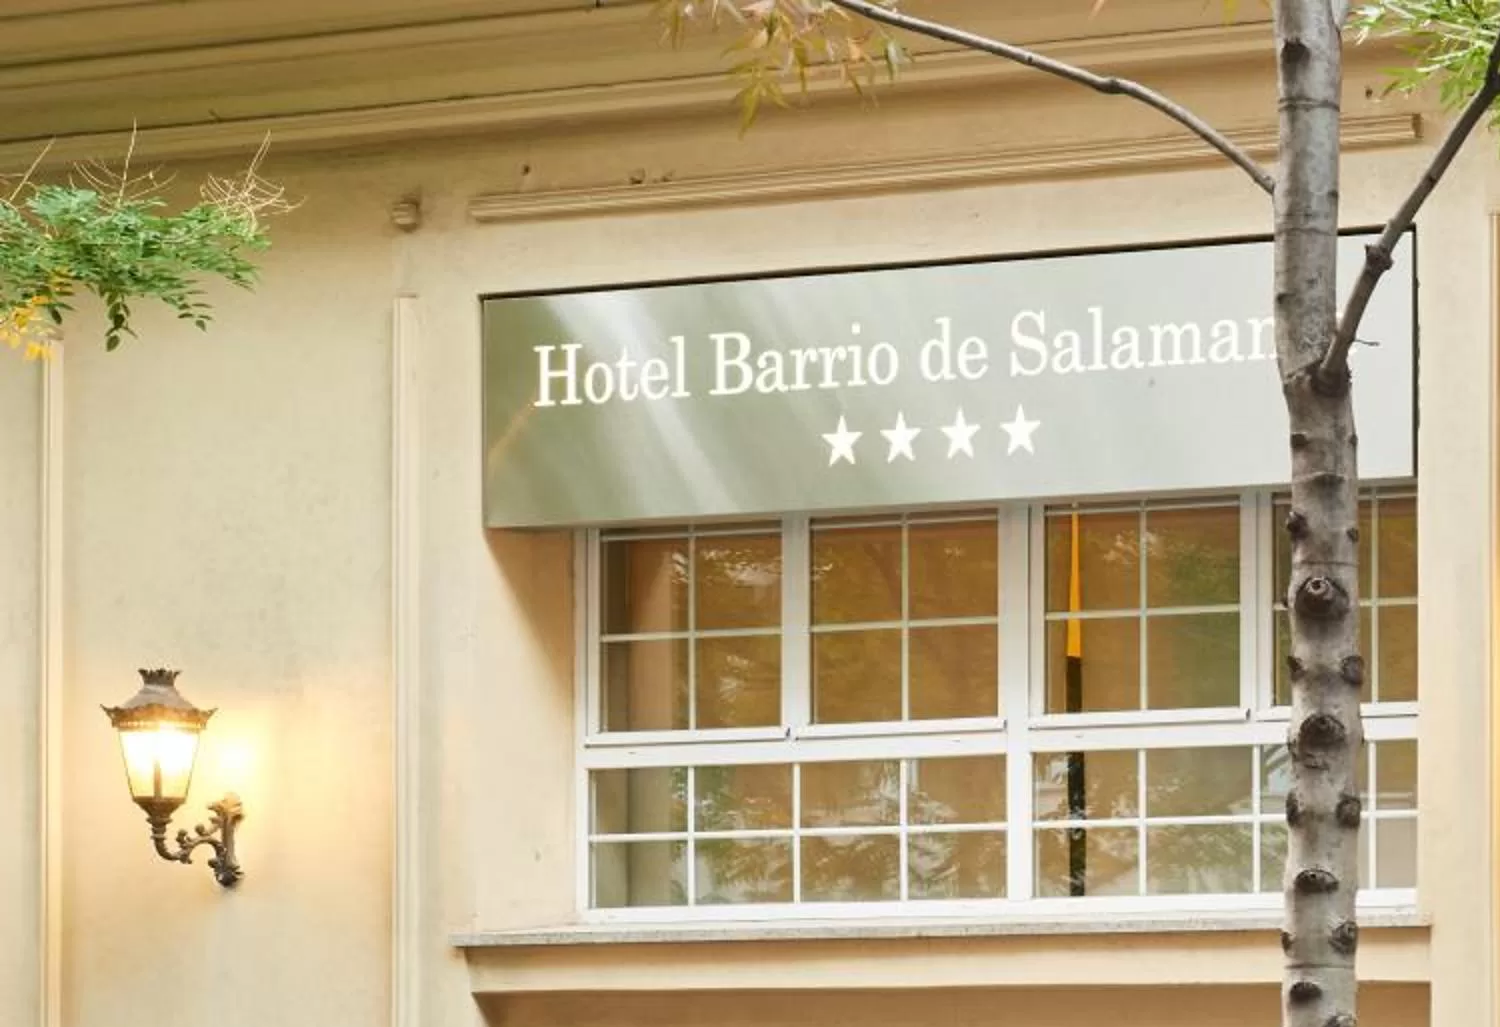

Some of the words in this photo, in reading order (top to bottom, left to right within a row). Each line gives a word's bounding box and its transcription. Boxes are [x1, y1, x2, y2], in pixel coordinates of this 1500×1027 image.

[533, 336, 690, 408] Hotel
[709, 324, 898, 396] Barrio
[920, 317, 988, 381] de
